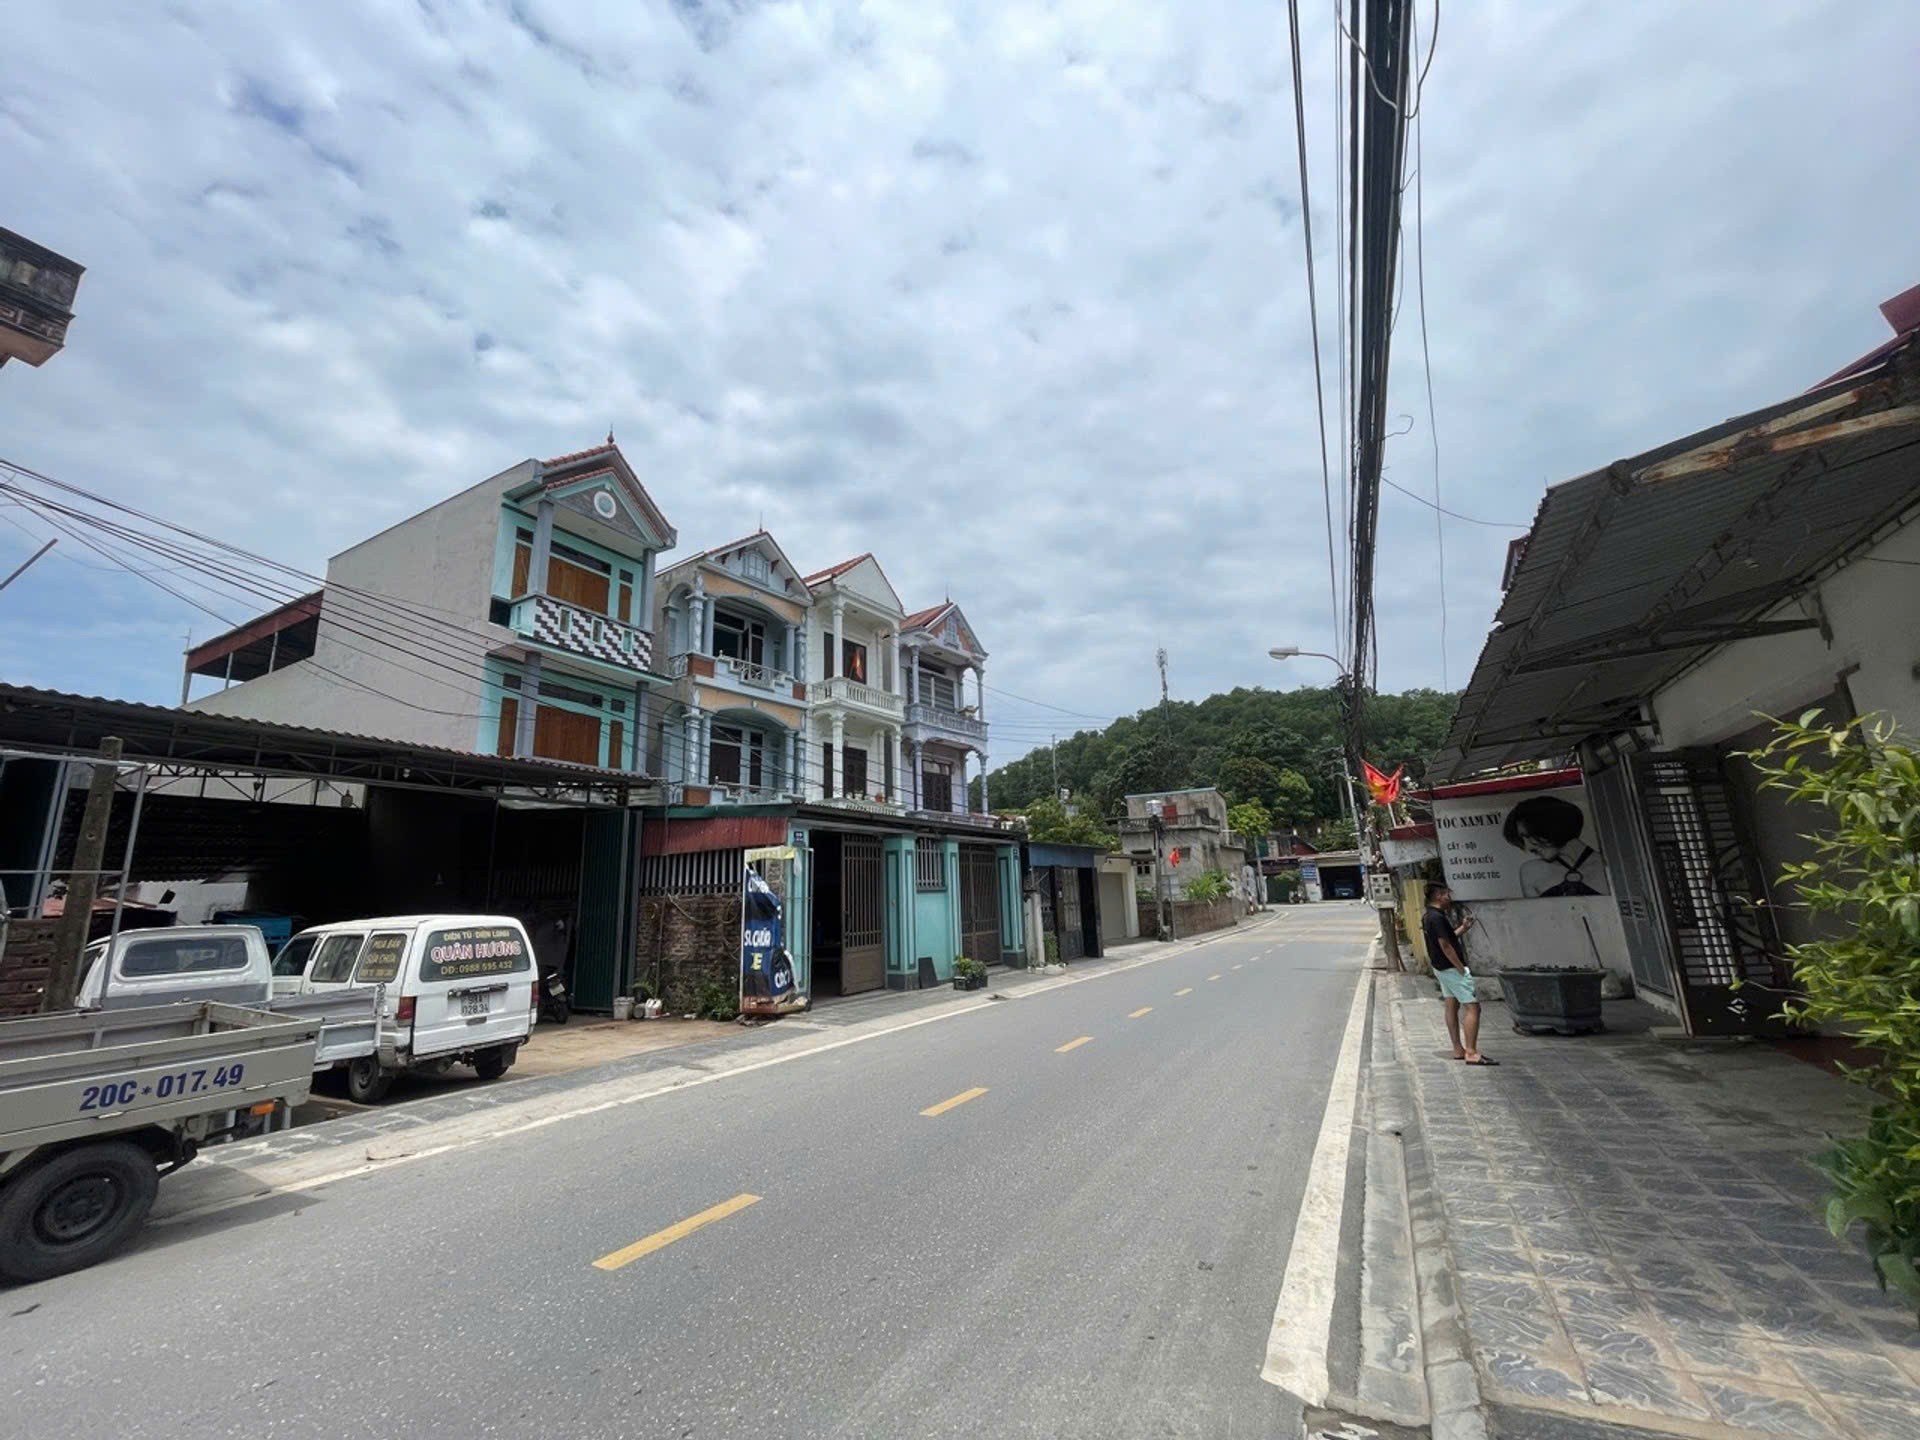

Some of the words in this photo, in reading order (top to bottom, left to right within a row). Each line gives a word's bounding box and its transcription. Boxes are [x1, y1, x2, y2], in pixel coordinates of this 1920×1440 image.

[1460, 815, 1483, 828] NAM
[80, 1080, 138, 1112] 20C
[156, 1063, 244, 1098] 017.49
